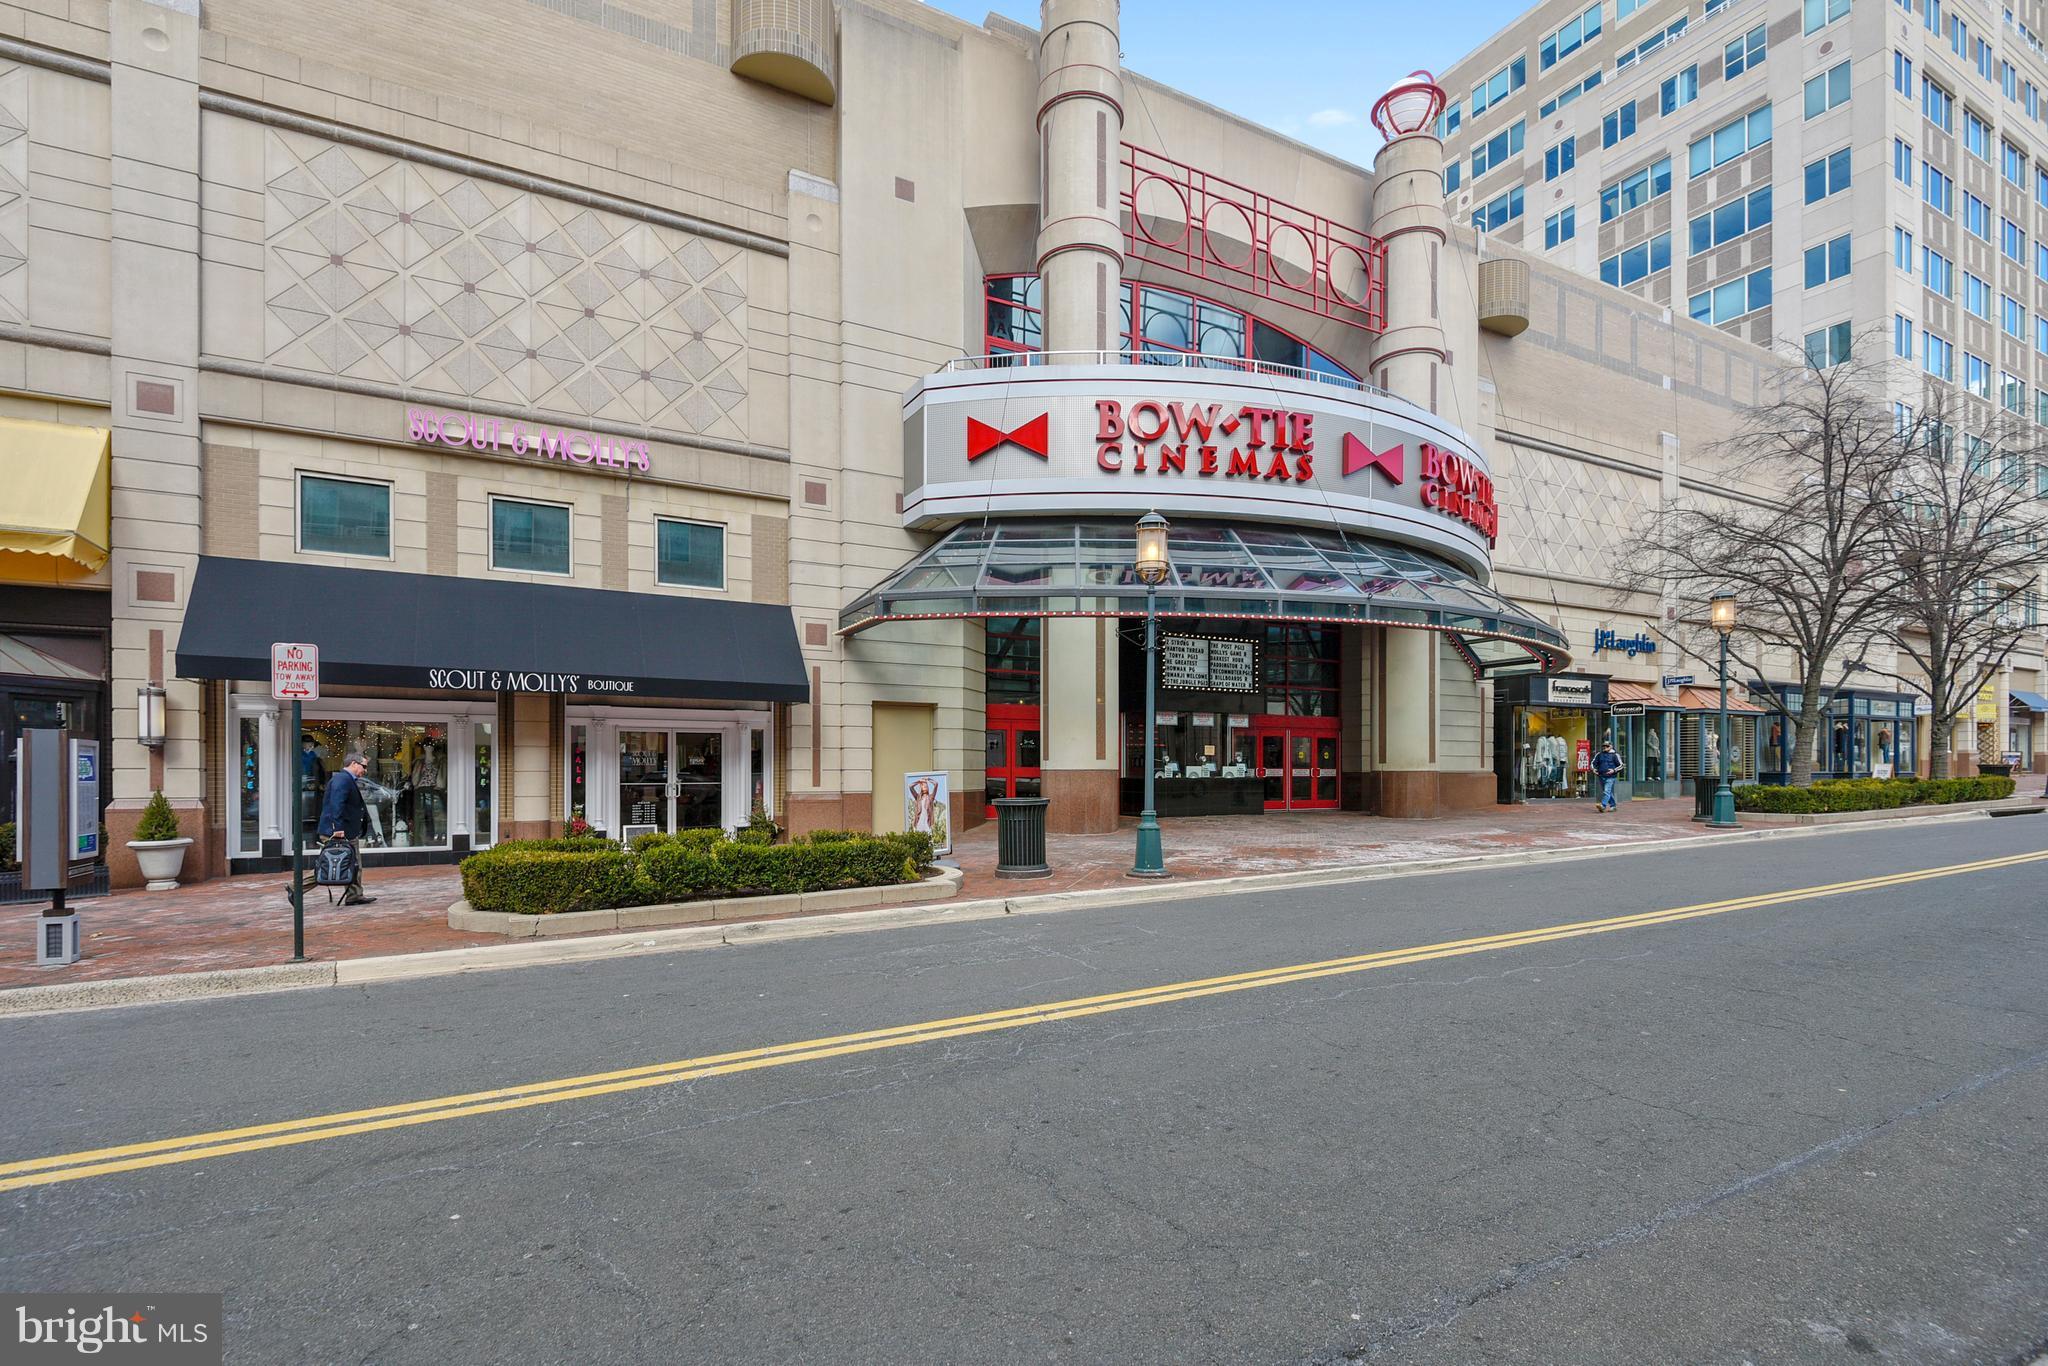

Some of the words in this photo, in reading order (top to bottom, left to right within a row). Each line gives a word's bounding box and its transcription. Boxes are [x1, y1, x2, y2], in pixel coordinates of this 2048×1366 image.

[408, 407, 501, 450] SCOUT
[512, 422, 529, 455] &
[537, 427, 650, 472] MOLLY'S
[1097, 442, 1314, 482] CINEMAS
[1419, 442, 1475, 495] BOW
[1420, 481, 1498, 550] CINEM
[278, 660, 312, 672] PARKING
[287, 649, 303, 660] NO
[276, 672, 291, 680] TOW
[285, 682, 306, 690] ZONE
[429, 668, 486, 690] SCOUT
[491, 671, 502, 690] &
[506, 672, 578, 692] MOLLY'S
[588, 680, 634, 692] BOUTIQUE
[246, 746, 255, 790] SALE
[479, 746, 489, 788] SALE
